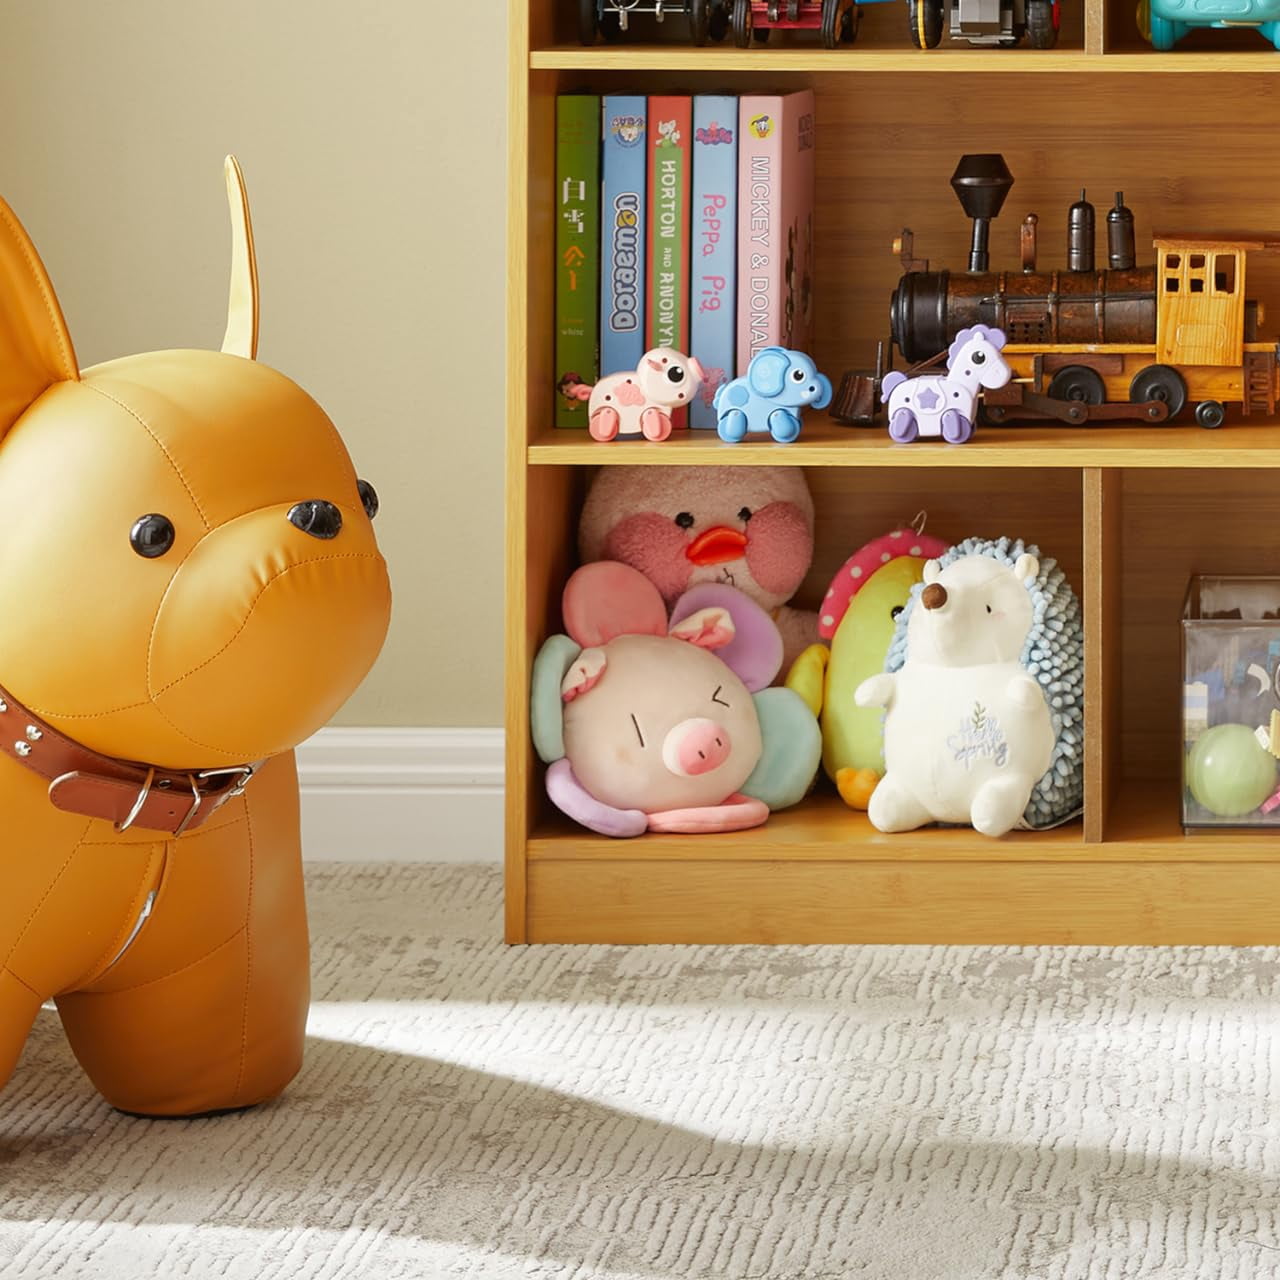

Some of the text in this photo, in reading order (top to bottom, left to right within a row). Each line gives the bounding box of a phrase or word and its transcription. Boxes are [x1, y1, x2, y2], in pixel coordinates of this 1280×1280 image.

[660, 160, 677, 238] HORTON
[751, 155, 770, 248] MICKEY
[663, 247, 672, 268] AND
[699, 193, 727, 313] Peppa Pig
[750, 253, 769, 270] &
